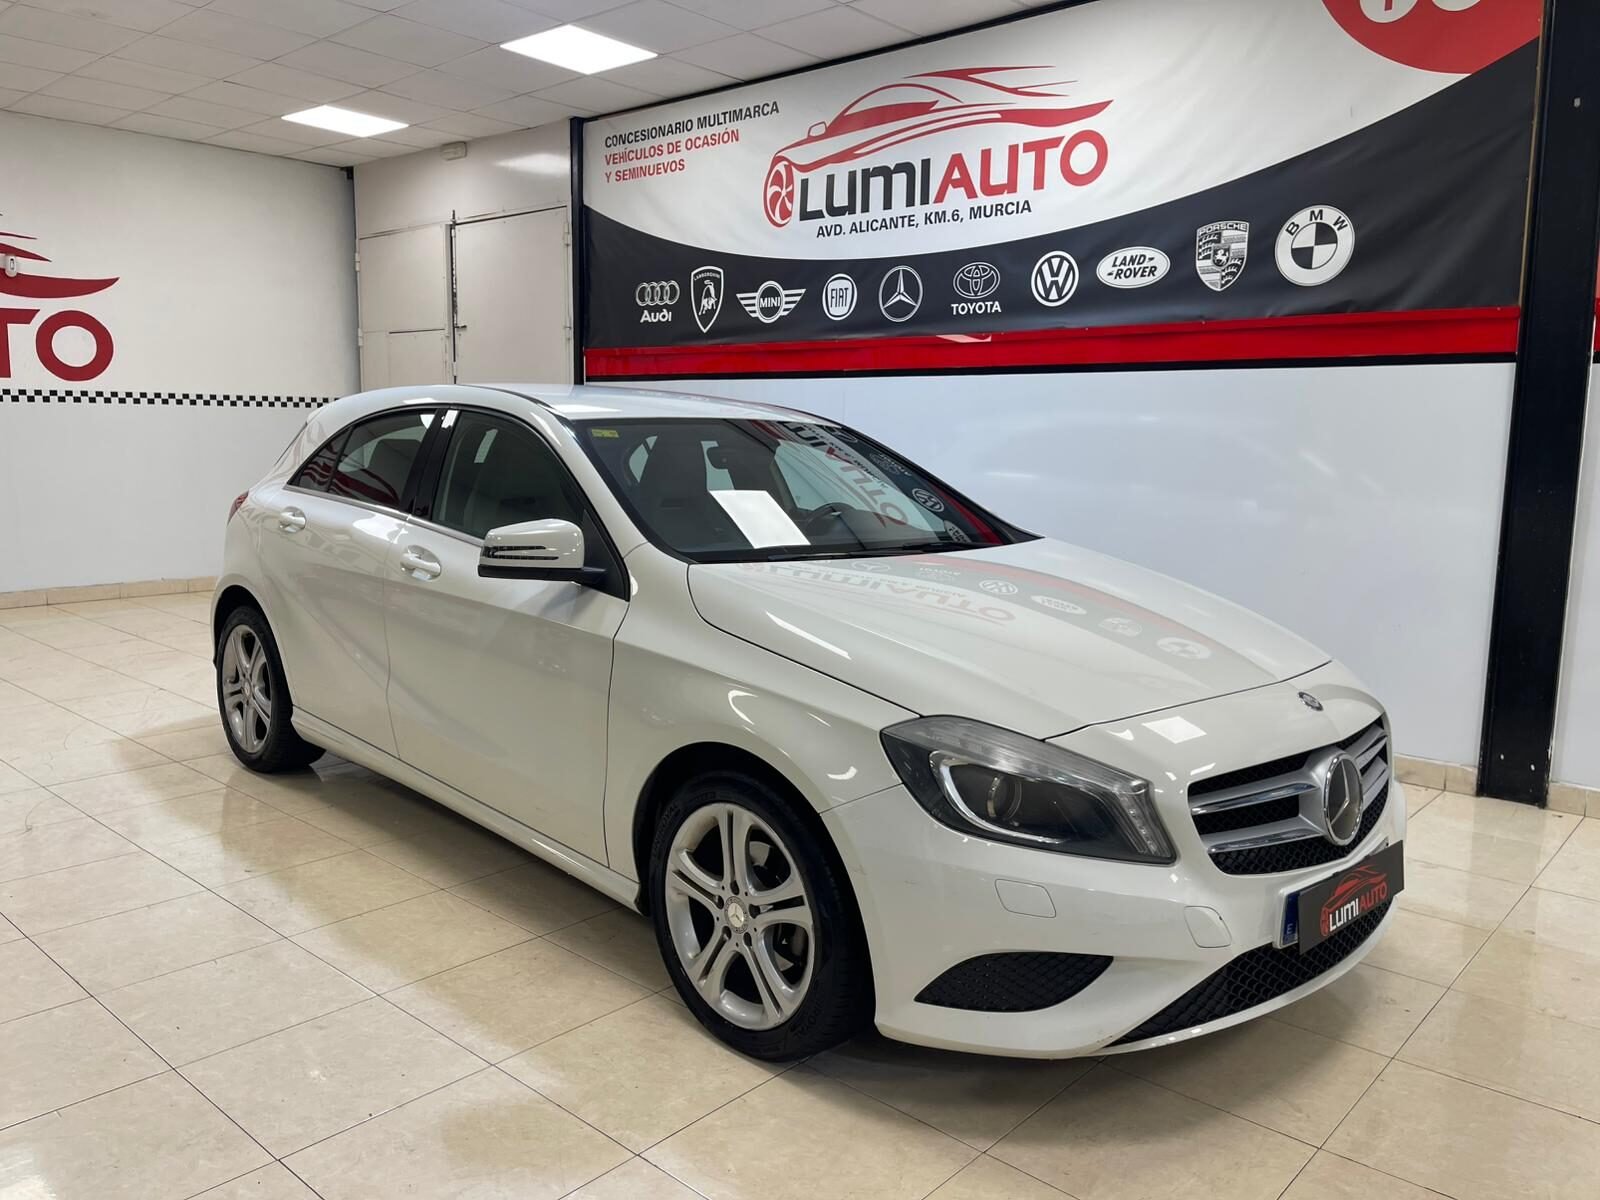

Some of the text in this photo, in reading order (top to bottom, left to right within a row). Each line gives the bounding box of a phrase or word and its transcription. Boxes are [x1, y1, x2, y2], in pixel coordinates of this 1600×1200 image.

[604, 100, 780, 148] CONCESIONARIO MULTIMARCA
[604, 128, 740, 166] VEHÍCULOS DE OCASIÓN
[604, 158, 686, 183] Y SEMINUEVOS
[816, 200, 1032, 238] AVD. ALICANTE, KM.6, MURCIA
[1199, 222, 1247, 235] PORSCHE
[1285, 209, 1348, 236] BMW
[759, 296, 782, 308] MINI
[830, 287, 849, 308] FIAT
[951, 301, 1002, 315] TOYOTA
[640, 309, 672, 323] Audi
[1329, 881, 1387, 932] LUMIAUTO
[1286, 923, 1294, 935] E
